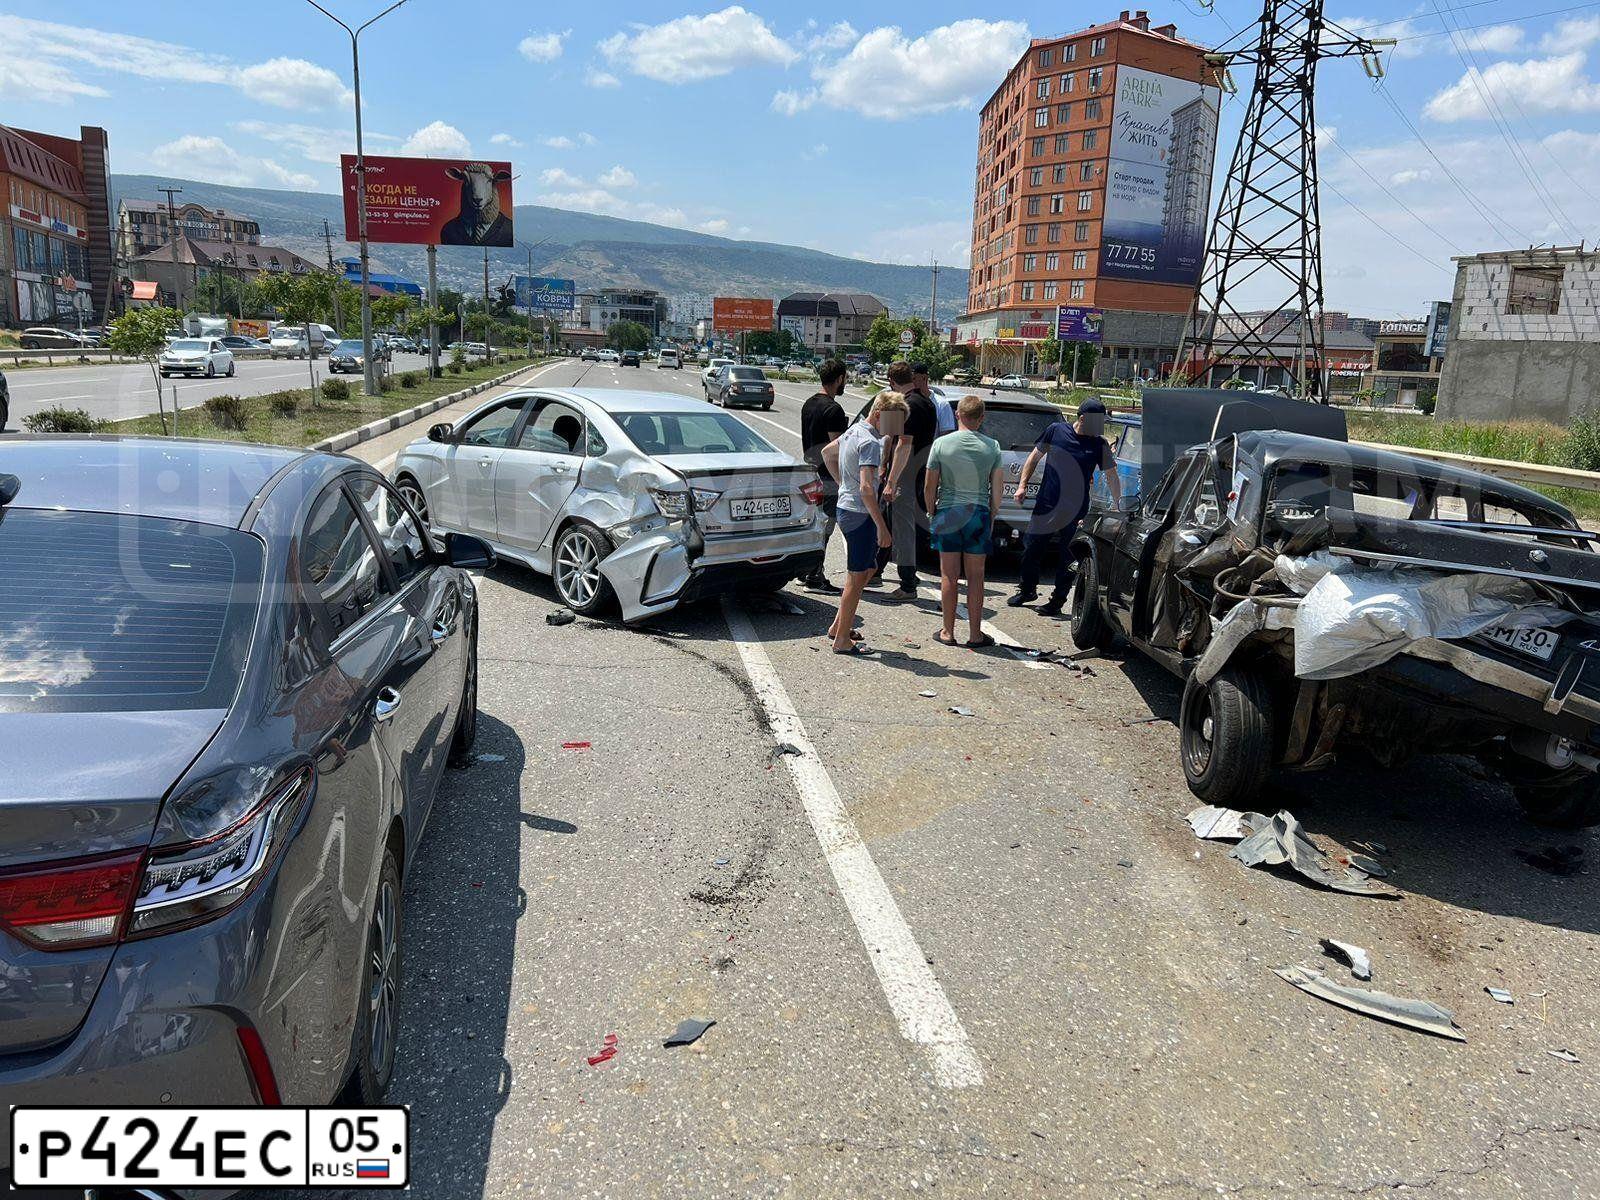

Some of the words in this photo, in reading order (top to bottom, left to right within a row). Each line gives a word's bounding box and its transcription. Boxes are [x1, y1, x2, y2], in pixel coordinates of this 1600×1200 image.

[1121, 90, 1152, 108] PARK
[1128, 131, 1158, 148] ЖИТЬ
[404, 184, 417, 195] НЕ
[1108, 244, 1121, 258] 77
[1125, 245, 1138, 260] 77
[1141, 248, 1156, 262] 55
[537, 294, 570, 304] КОВРЫ
[1380, 320, 1424, 333] LOUNGE
[777, 498, 787, 509] 05
[1520, 628, 1548, 647] 30
[1519, 642, 1538, 653] RUS
